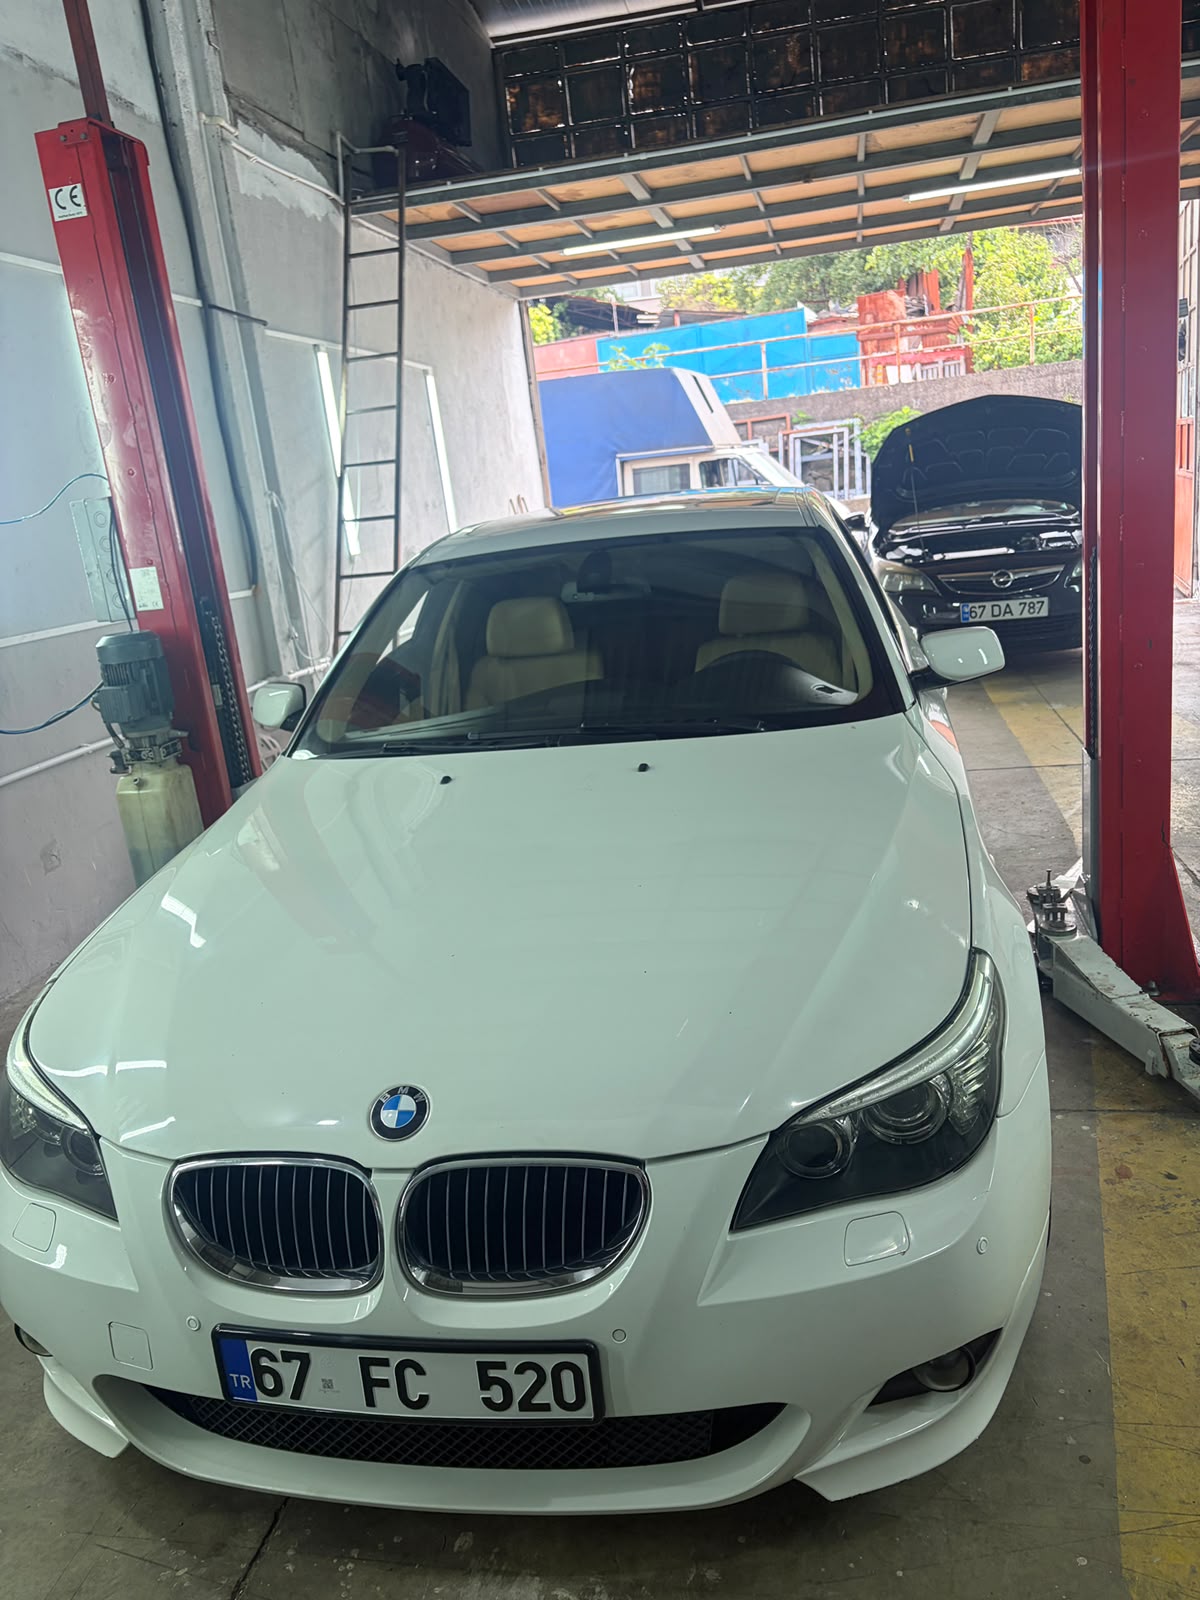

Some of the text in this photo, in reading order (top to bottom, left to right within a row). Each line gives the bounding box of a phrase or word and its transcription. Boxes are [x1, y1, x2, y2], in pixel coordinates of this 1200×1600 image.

[55, 185, 81, 210] CE
[970, 600, 1045, 619] 67 DA 787
[380, 1086, 425, 1103] BMW
[229, 1347, 586, 1413] TR 67 FC 520
